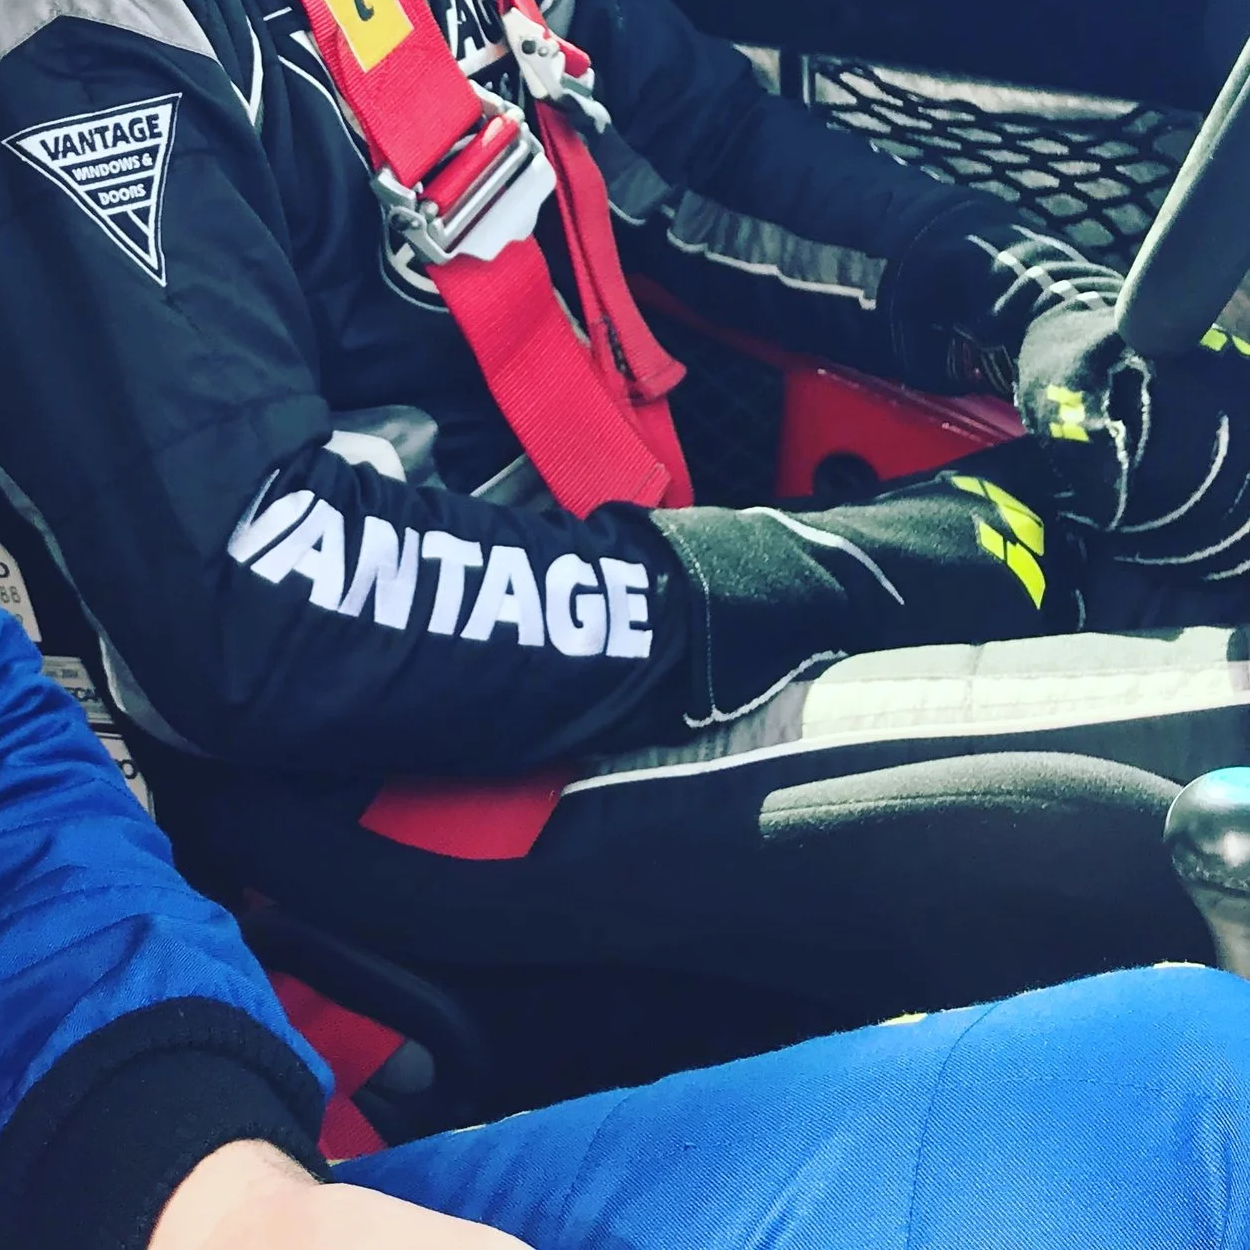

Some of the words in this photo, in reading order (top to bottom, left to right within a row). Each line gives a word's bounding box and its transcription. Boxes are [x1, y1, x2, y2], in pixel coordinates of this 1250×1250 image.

[39, 113, 163, 161] VANTAGE
[71, 156, 140, 181] WINDOWS
[141, 152, 153, 166] &
[97, 183, 147, 206] DOORS
[227, 468, 653, 659] VANTAGE
